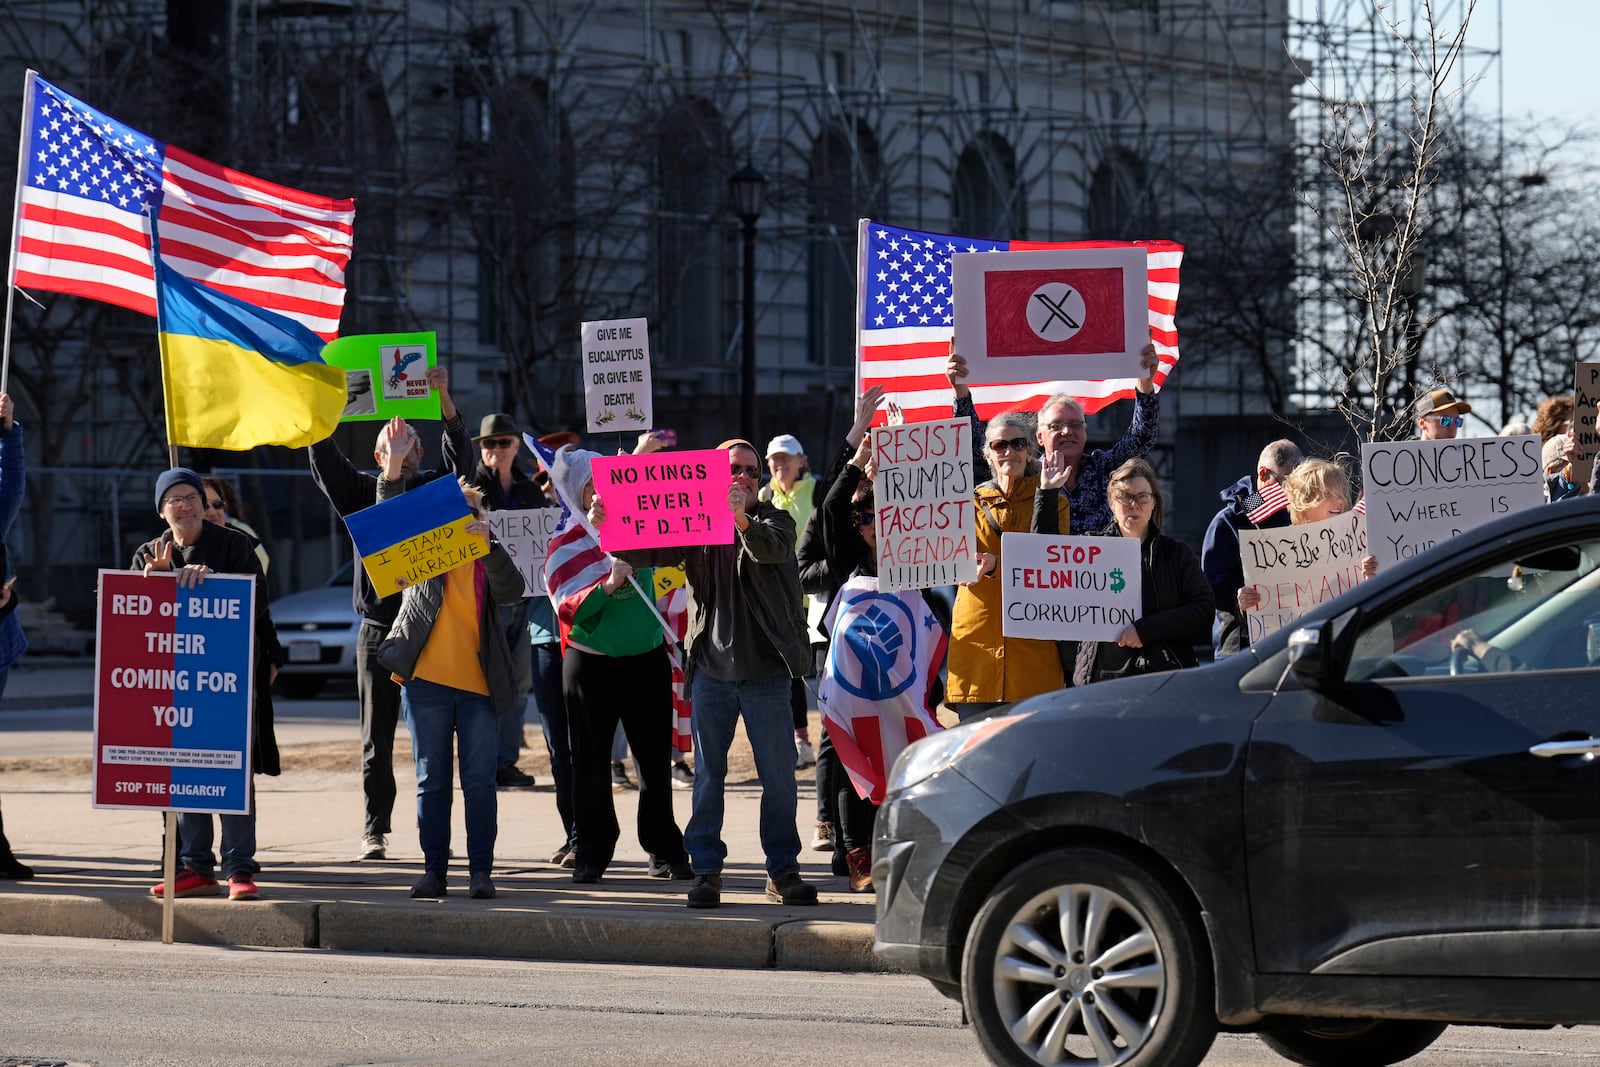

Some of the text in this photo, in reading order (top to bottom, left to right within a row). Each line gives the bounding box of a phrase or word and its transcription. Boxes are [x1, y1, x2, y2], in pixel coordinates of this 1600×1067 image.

[597, 327, 632, 340] GIVE ME
[588, 348, 644, 363] EUCALYPTUS
[406, 379, 427, 387] NEVER
[593, 370, 642, 384] OR GIVE ME
[604, 393, 634, 406] DEATH!
[876, 422, 968, 467] RESIST
[610, 464, 707, 485] NO KINGS
[1369, 440, 1538, 486] CONGRESS
[879, 460, 970, 501] TRUMP'S
[878, 500, 970, 538] FASCIST
[1386, 496, 1509, 523] WHERE IS
[489, 515, 554, 538] MERIC
[375, 527, 454, 566] I STAND
[408, 544, 443, 564] WITH
[879, 535, 970, 568] AGENDA
[1046, 545, 1102, 565] STOP
[1249, 536, 1289, 573] We
[1320, 515, 1367, 564] People
[406, 542, 480, 581] UKRAINE
[1012, 568, 1126, 593] FELONIOU$
[112, 594, 240, 620] RED or BLUE
[1008, 602, 1135, 625] CORRUPTION
[1249, 609, 1307, 644] DEM
[145, 632, 205, 654] THEIR
[111, 667, 237, 693] COMING FOR
[152, 706, 193, 727] YOU
[115, 782, 226, 797] STOP THE OLIGARCHY
